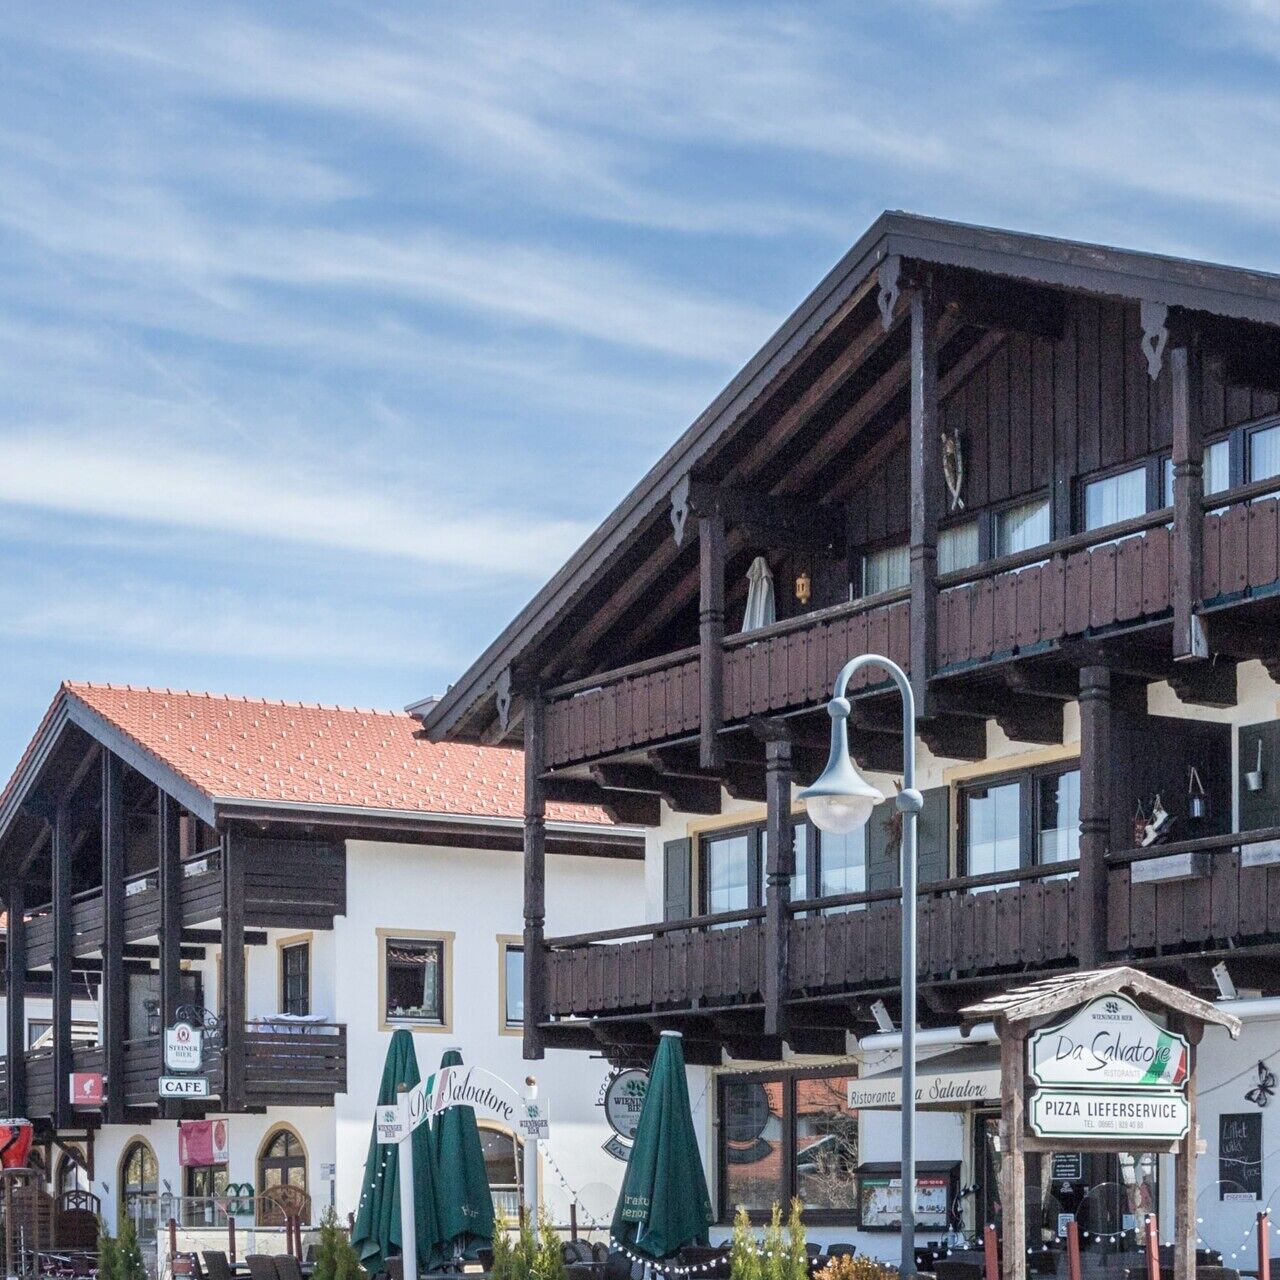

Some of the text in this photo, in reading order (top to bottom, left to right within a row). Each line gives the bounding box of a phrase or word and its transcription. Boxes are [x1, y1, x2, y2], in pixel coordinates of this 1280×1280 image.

[1056, 1030, 1171, 1071] Da Salvatore
[166, 1082, 202, 1092] CAFE
[411, 1071, 514, 1121] Da Salvatore
[851, 1090, 896, 1105] Ristorante
[929, 1078, 988, 1100] Salvatore
[1045, 1101, 1177, 1118] PIZZA LIEFERSERVICE
